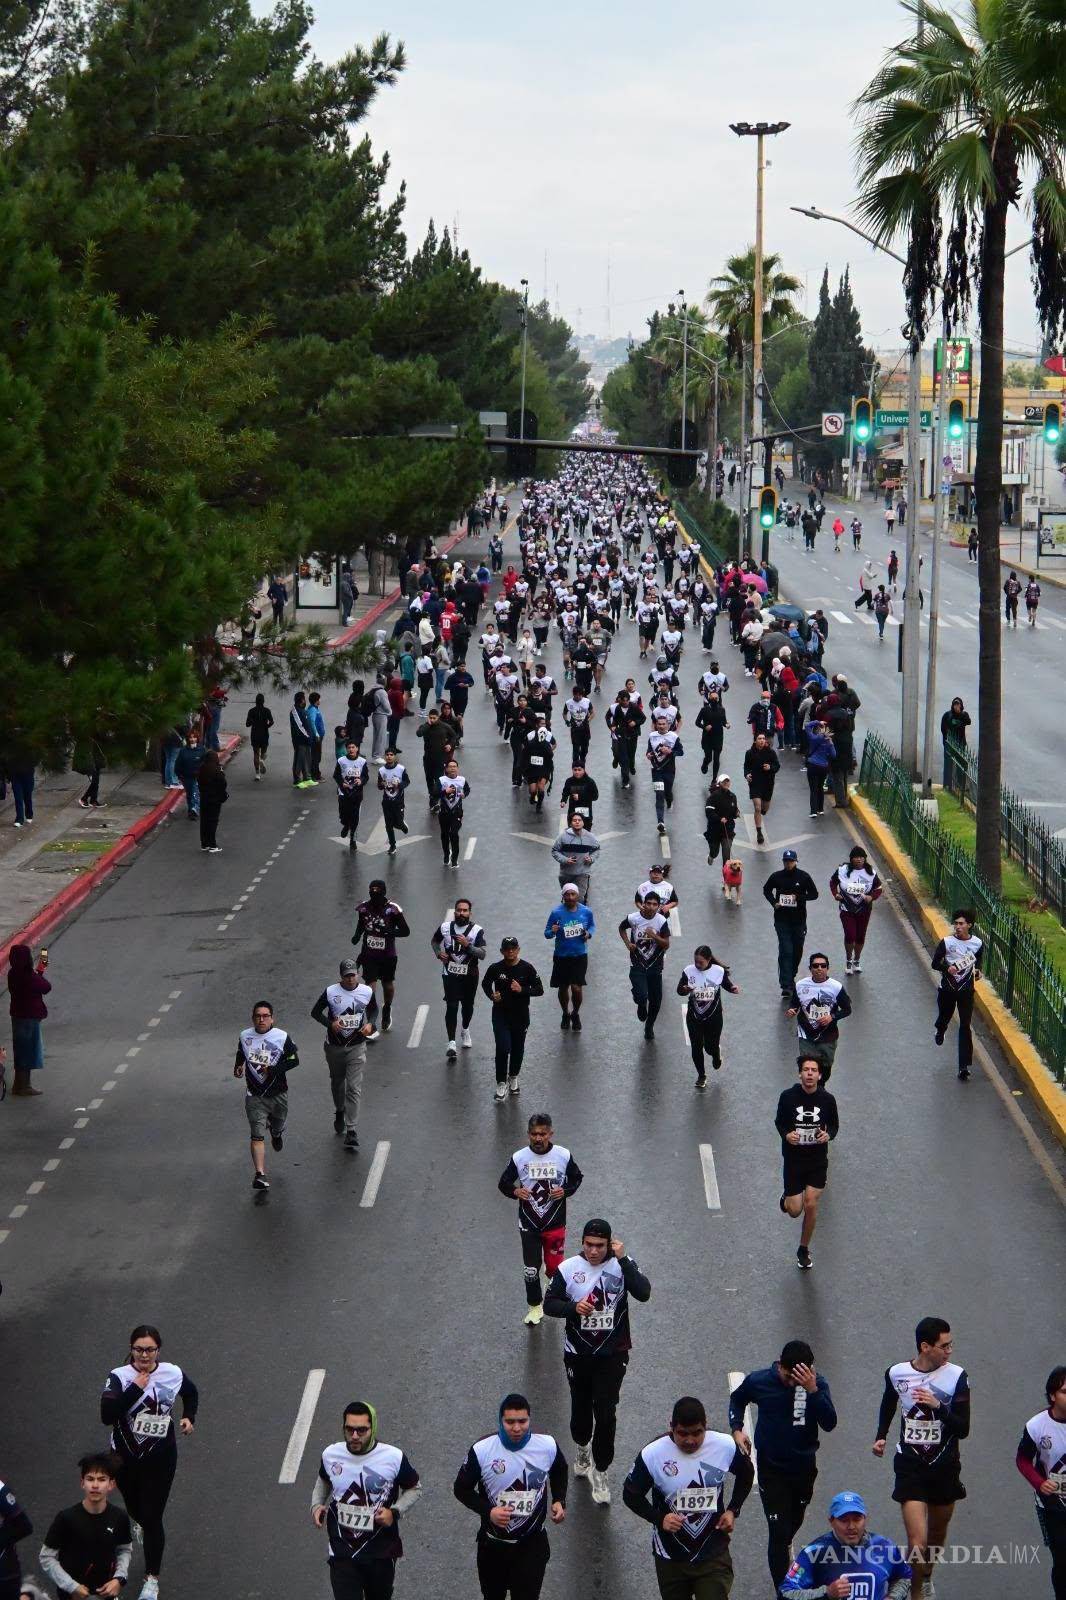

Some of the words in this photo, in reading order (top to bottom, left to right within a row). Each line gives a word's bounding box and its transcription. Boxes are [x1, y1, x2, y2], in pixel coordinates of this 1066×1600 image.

[881, 414, 927, 423] Universd
[530, 1167, 555, 1177] 1744
[582, 1316, 613, 1328] 2319
[136, 1420, 167, 1434] 1833
[906, 1427, 940, 1441] 2575
[680, 1495, 714, 1509] 1897
[339, 1511, 371, 1527] 1777
